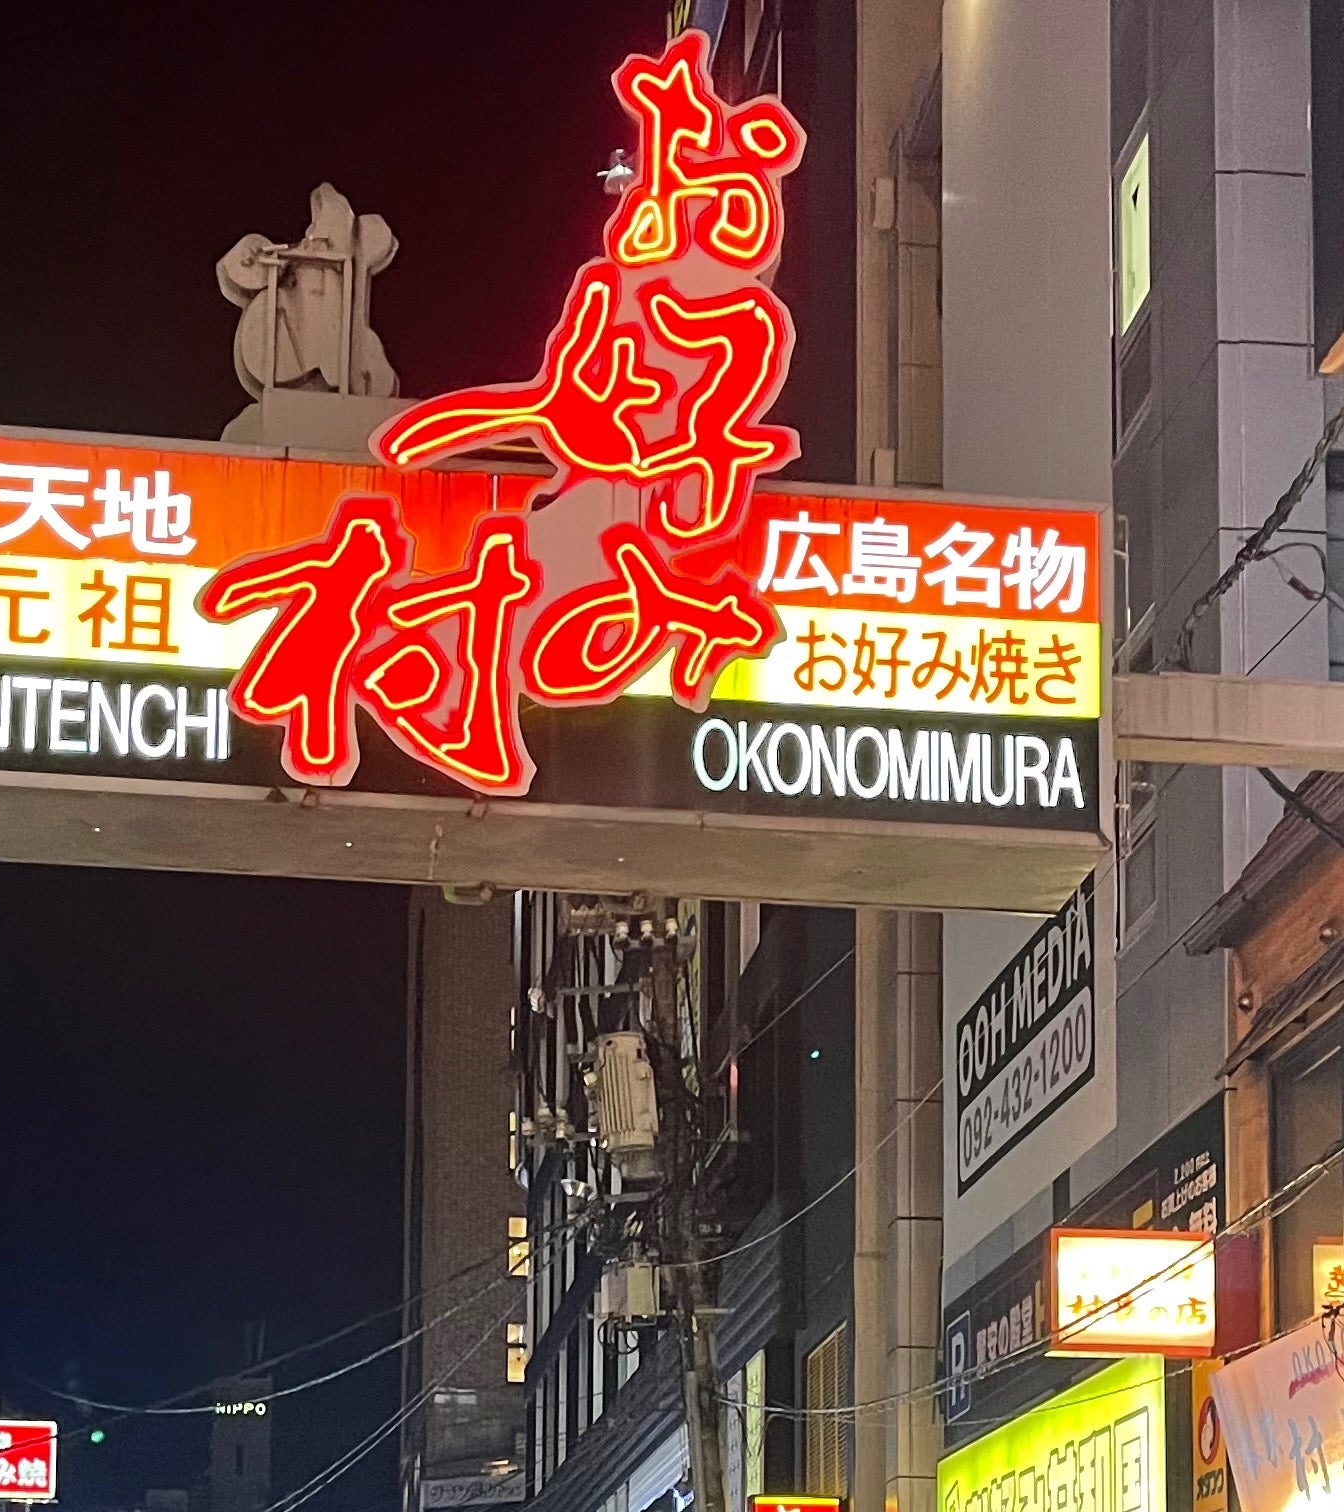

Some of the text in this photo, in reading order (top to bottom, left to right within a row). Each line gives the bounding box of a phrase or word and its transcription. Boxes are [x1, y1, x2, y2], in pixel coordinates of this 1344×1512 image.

[757, 519, 1088, 615] 広島名物
[793, 622, 1083, 706] お好み焼き
[691, 717, 1085, 810] OKONOMIMURA
[958, 893, 1091, 1097] OOH MEDIA
[963, 1002, 1088, 1169] 092-432-1200
